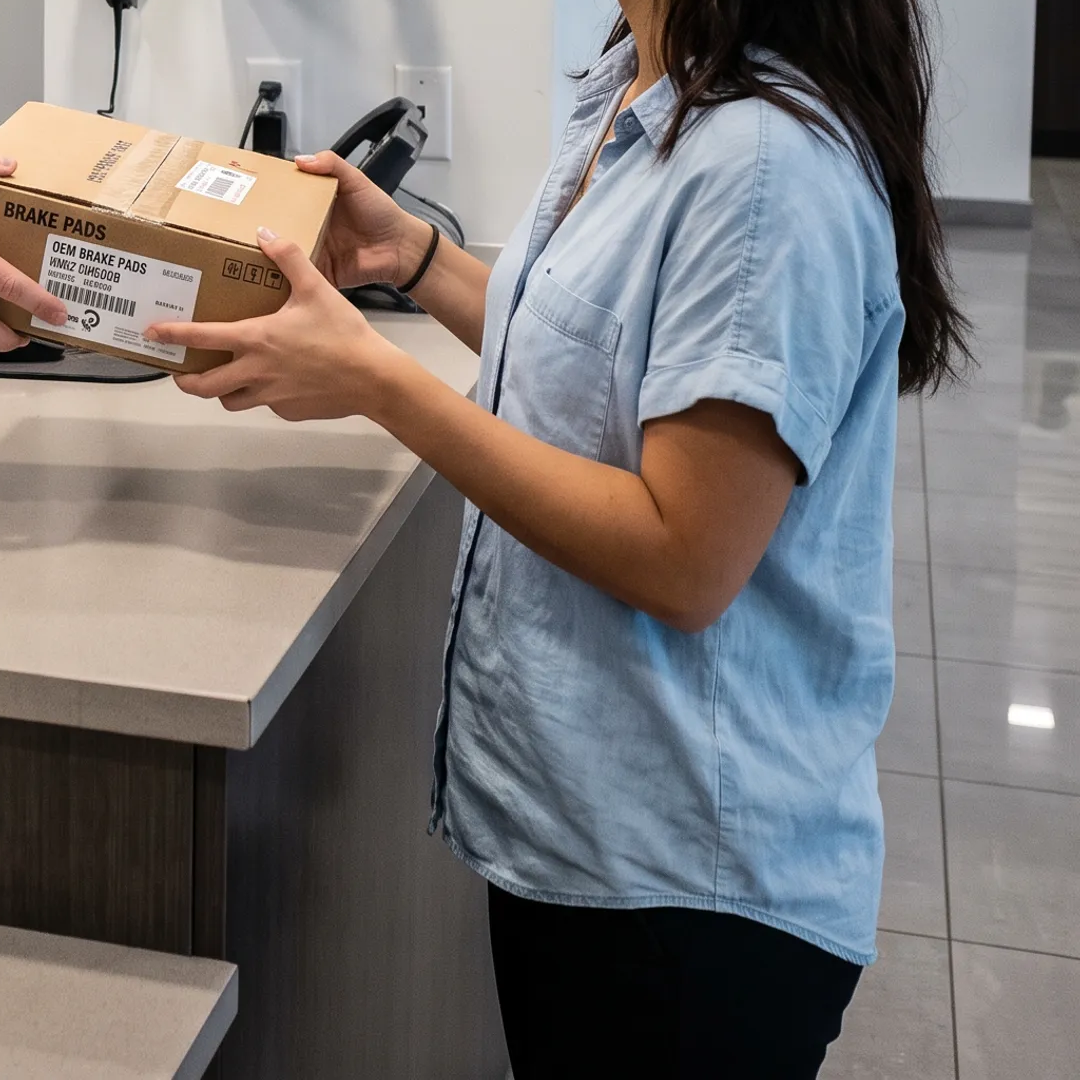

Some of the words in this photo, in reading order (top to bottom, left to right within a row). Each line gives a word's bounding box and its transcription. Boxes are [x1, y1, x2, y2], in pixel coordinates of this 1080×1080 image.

[3, 201, 60, 229] BRAKE
[62, 216, 107, 241] PADS
[52, 241, 77, 257] OEM
[117, 257, 148, 275] PADS
